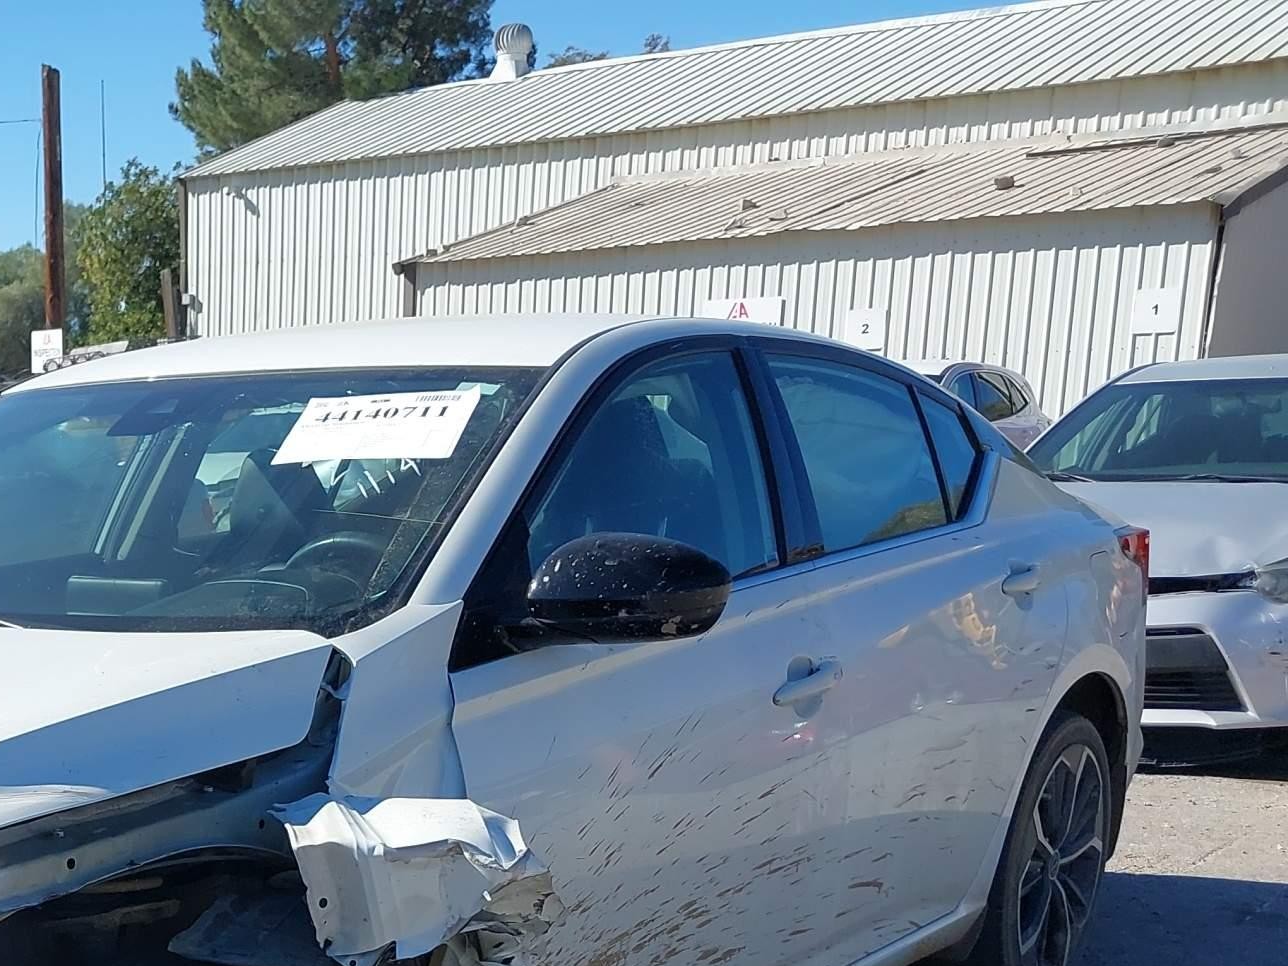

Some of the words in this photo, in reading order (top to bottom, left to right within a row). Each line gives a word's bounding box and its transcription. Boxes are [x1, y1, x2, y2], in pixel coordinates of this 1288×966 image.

[1152, 304, 1159, 315] 1
[861, 323, 870, 334] 2
[315, 405, 450, 423] 44140711
